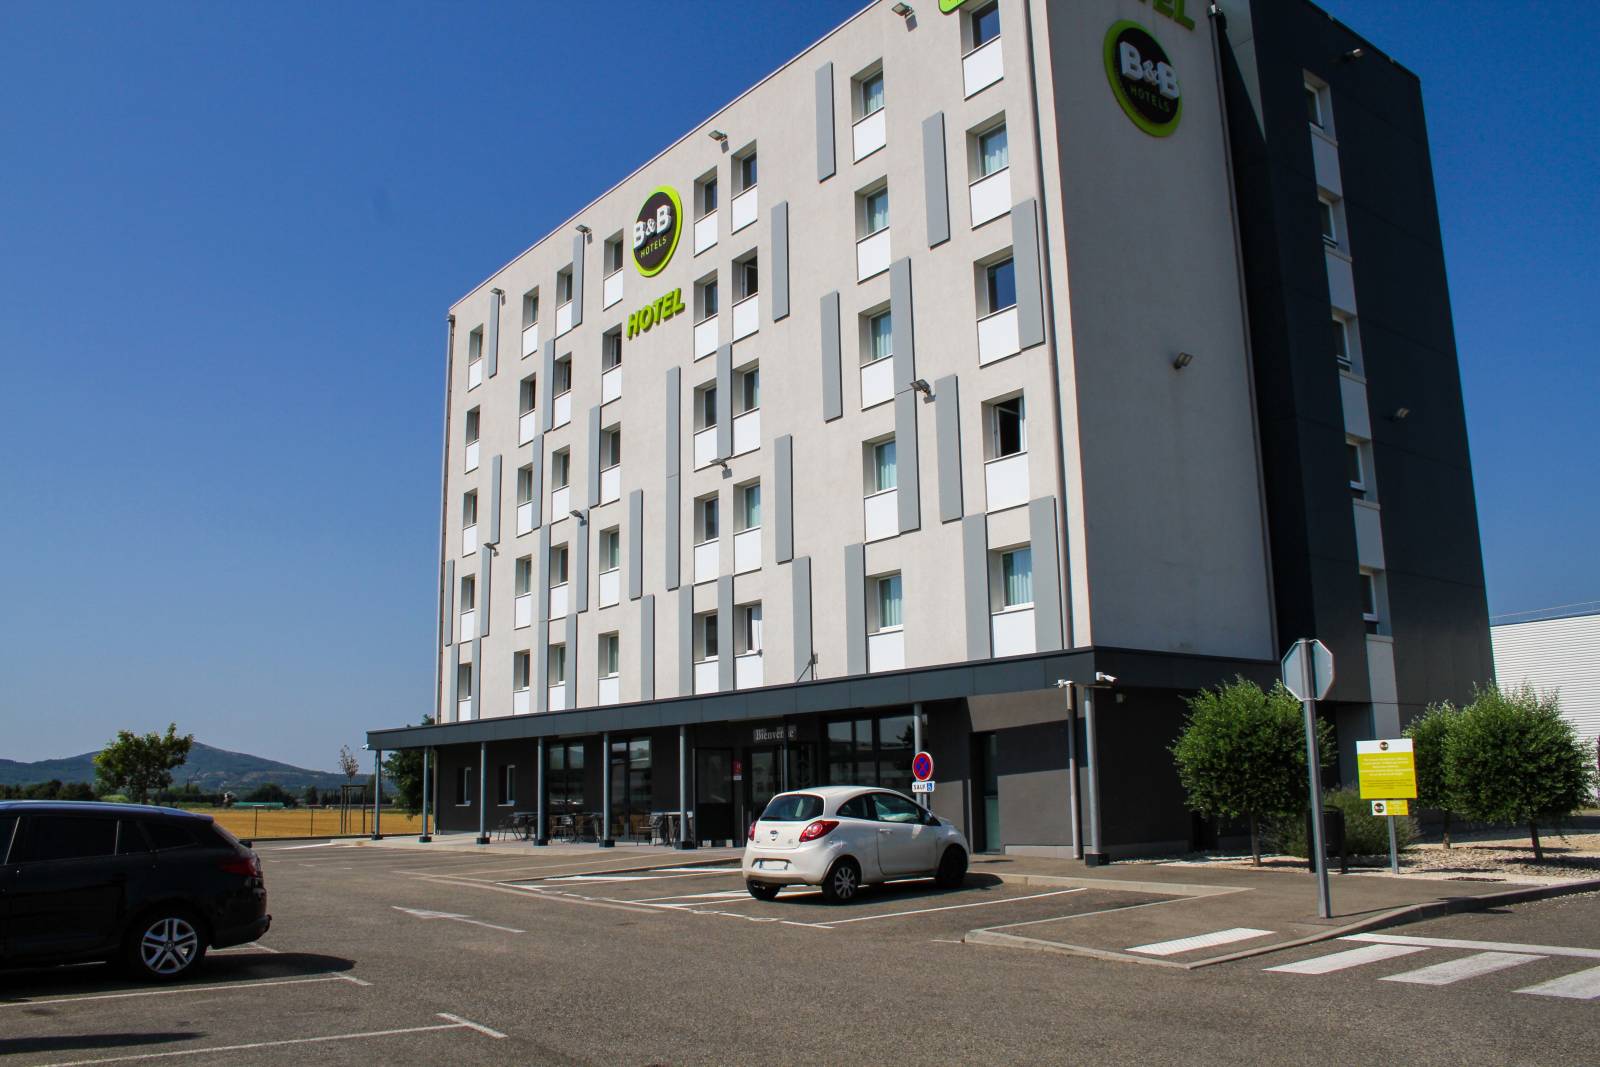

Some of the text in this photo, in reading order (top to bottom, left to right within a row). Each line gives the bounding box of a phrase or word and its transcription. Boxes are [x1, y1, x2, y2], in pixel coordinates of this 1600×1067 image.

[1120, 41, 1179, 98] B&B
[1130, 83, 1169, 112] HOTELS
[633, 205, 672, 250] B&B
[640, 236, 667, 258] HOTELS
[626, 288, 686, 340] HOTEL
